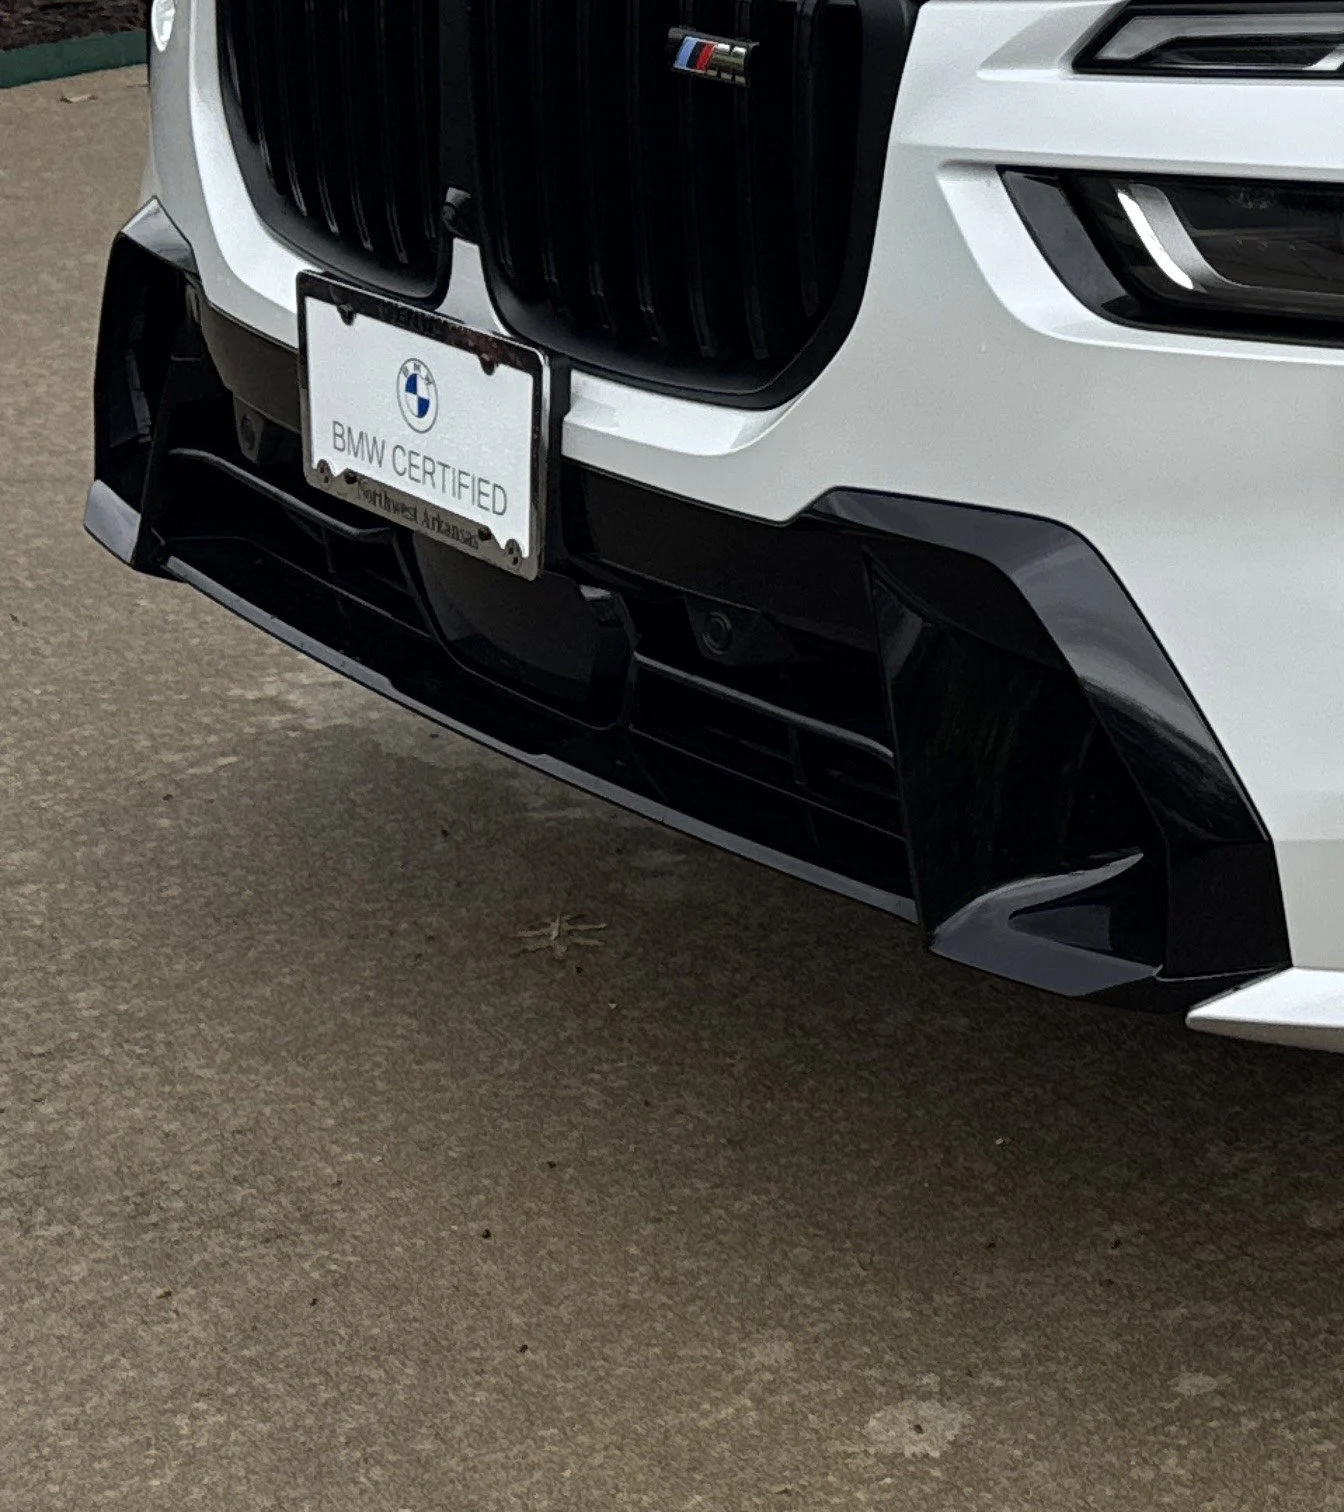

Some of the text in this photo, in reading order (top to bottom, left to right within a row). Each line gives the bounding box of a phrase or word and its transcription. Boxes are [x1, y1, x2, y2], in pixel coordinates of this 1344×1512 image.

[332, 420, 508, 516] BMW CERTIFIED
[356, 478, 479, 551] Northwest Arkansas
